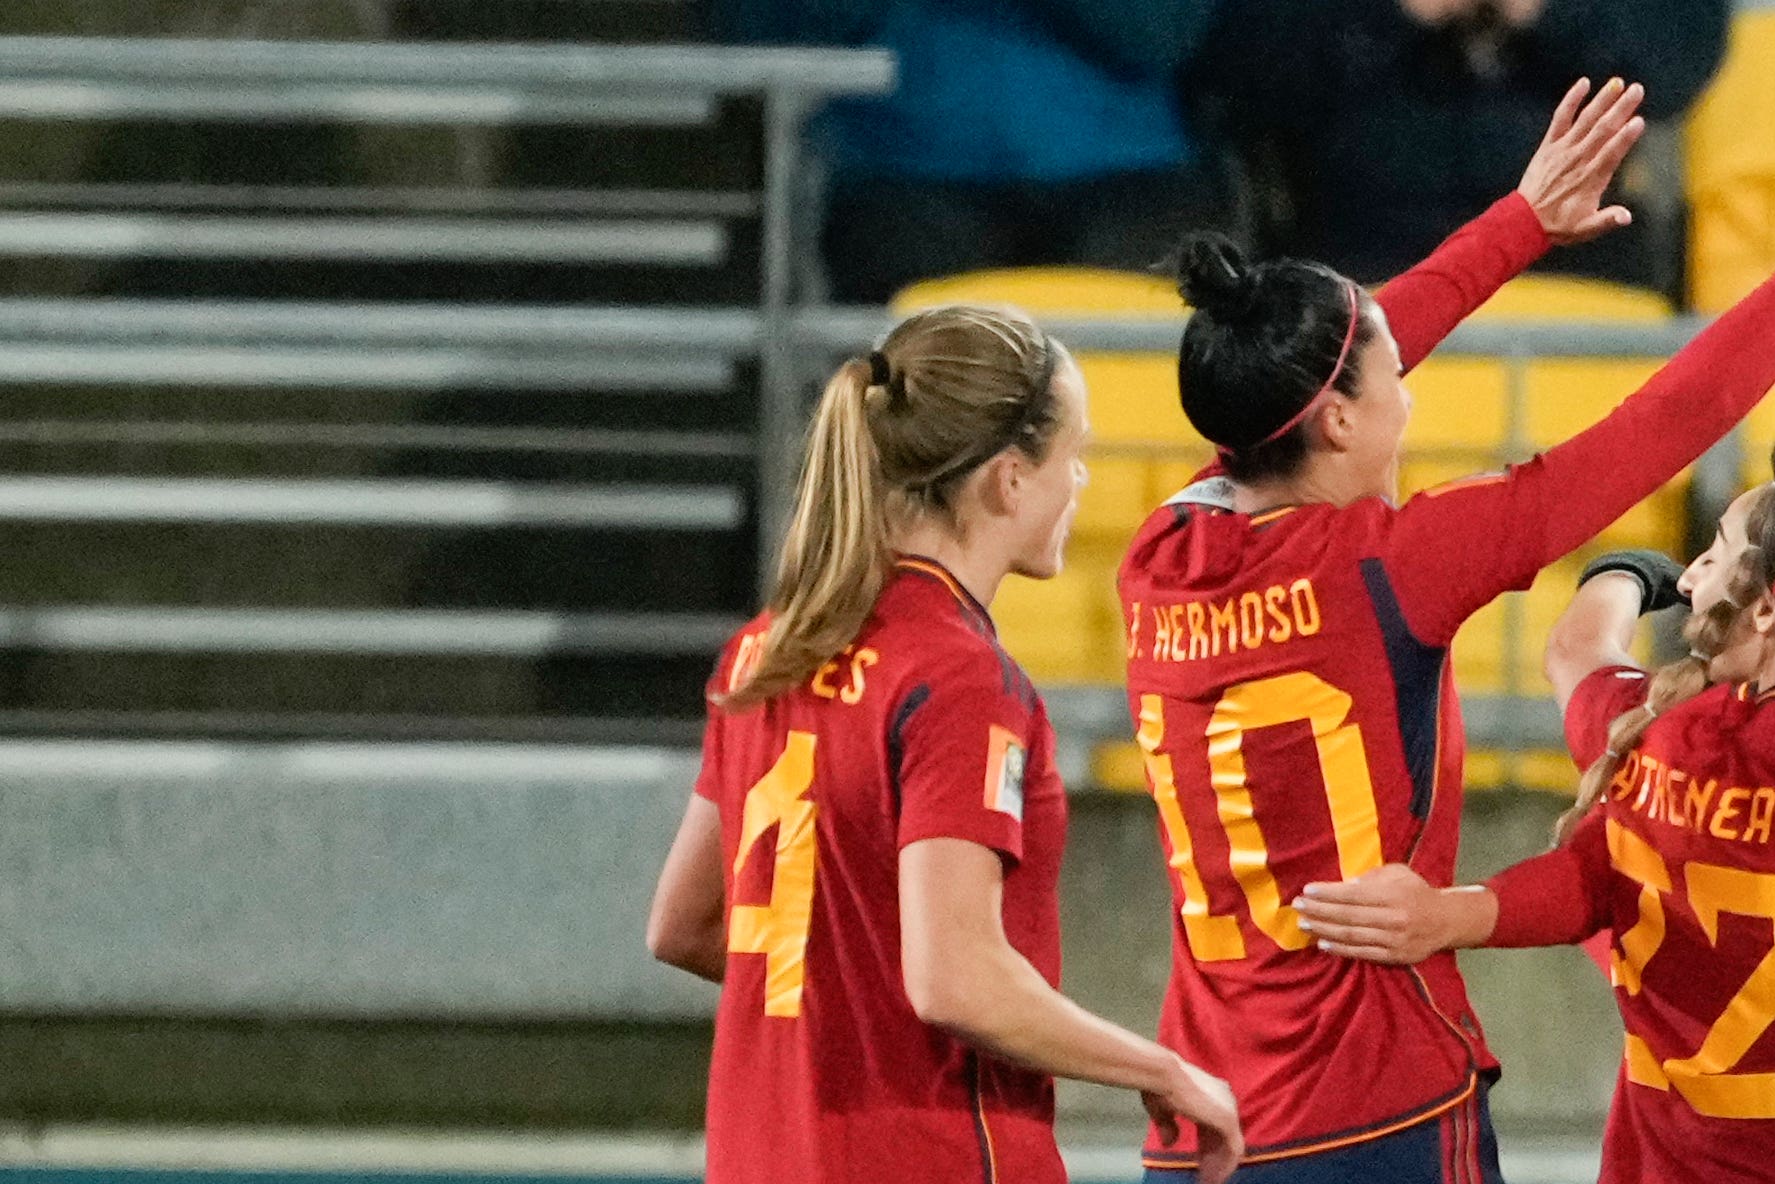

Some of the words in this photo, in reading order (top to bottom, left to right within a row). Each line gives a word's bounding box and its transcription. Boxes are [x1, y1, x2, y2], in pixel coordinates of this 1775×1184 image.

[1152, 577, 1322, 663] HERMOSO
[727, 730, 817, 1018] 4
[1136, 671, 1385, 962] 10
